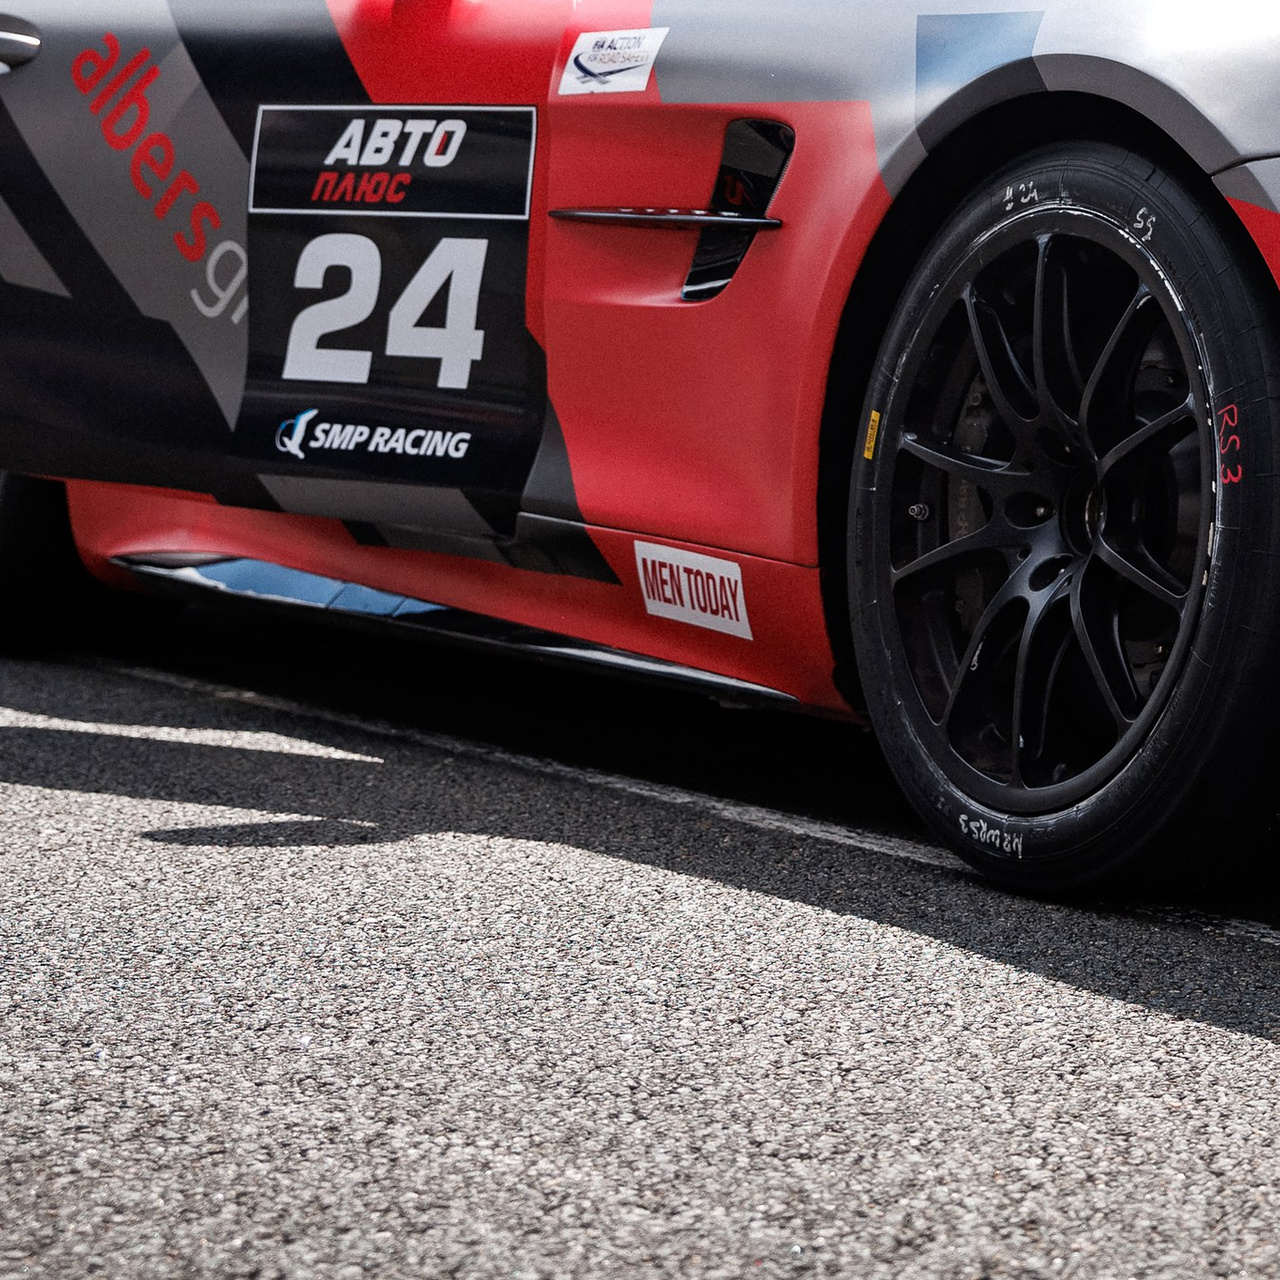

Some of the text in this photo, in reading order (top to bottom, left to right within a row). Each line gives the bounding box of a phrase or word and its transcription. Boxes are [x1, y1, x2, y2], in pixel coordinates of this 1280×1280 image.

[324, 119, 467, 167] АВТО
[312, 172, 411, 203] ПЛЮС
[282, 233, 488, 389] 24
[309, 424, 470, 458] SMP RACING
[642, 558, 740, 622] MEN TODAY
